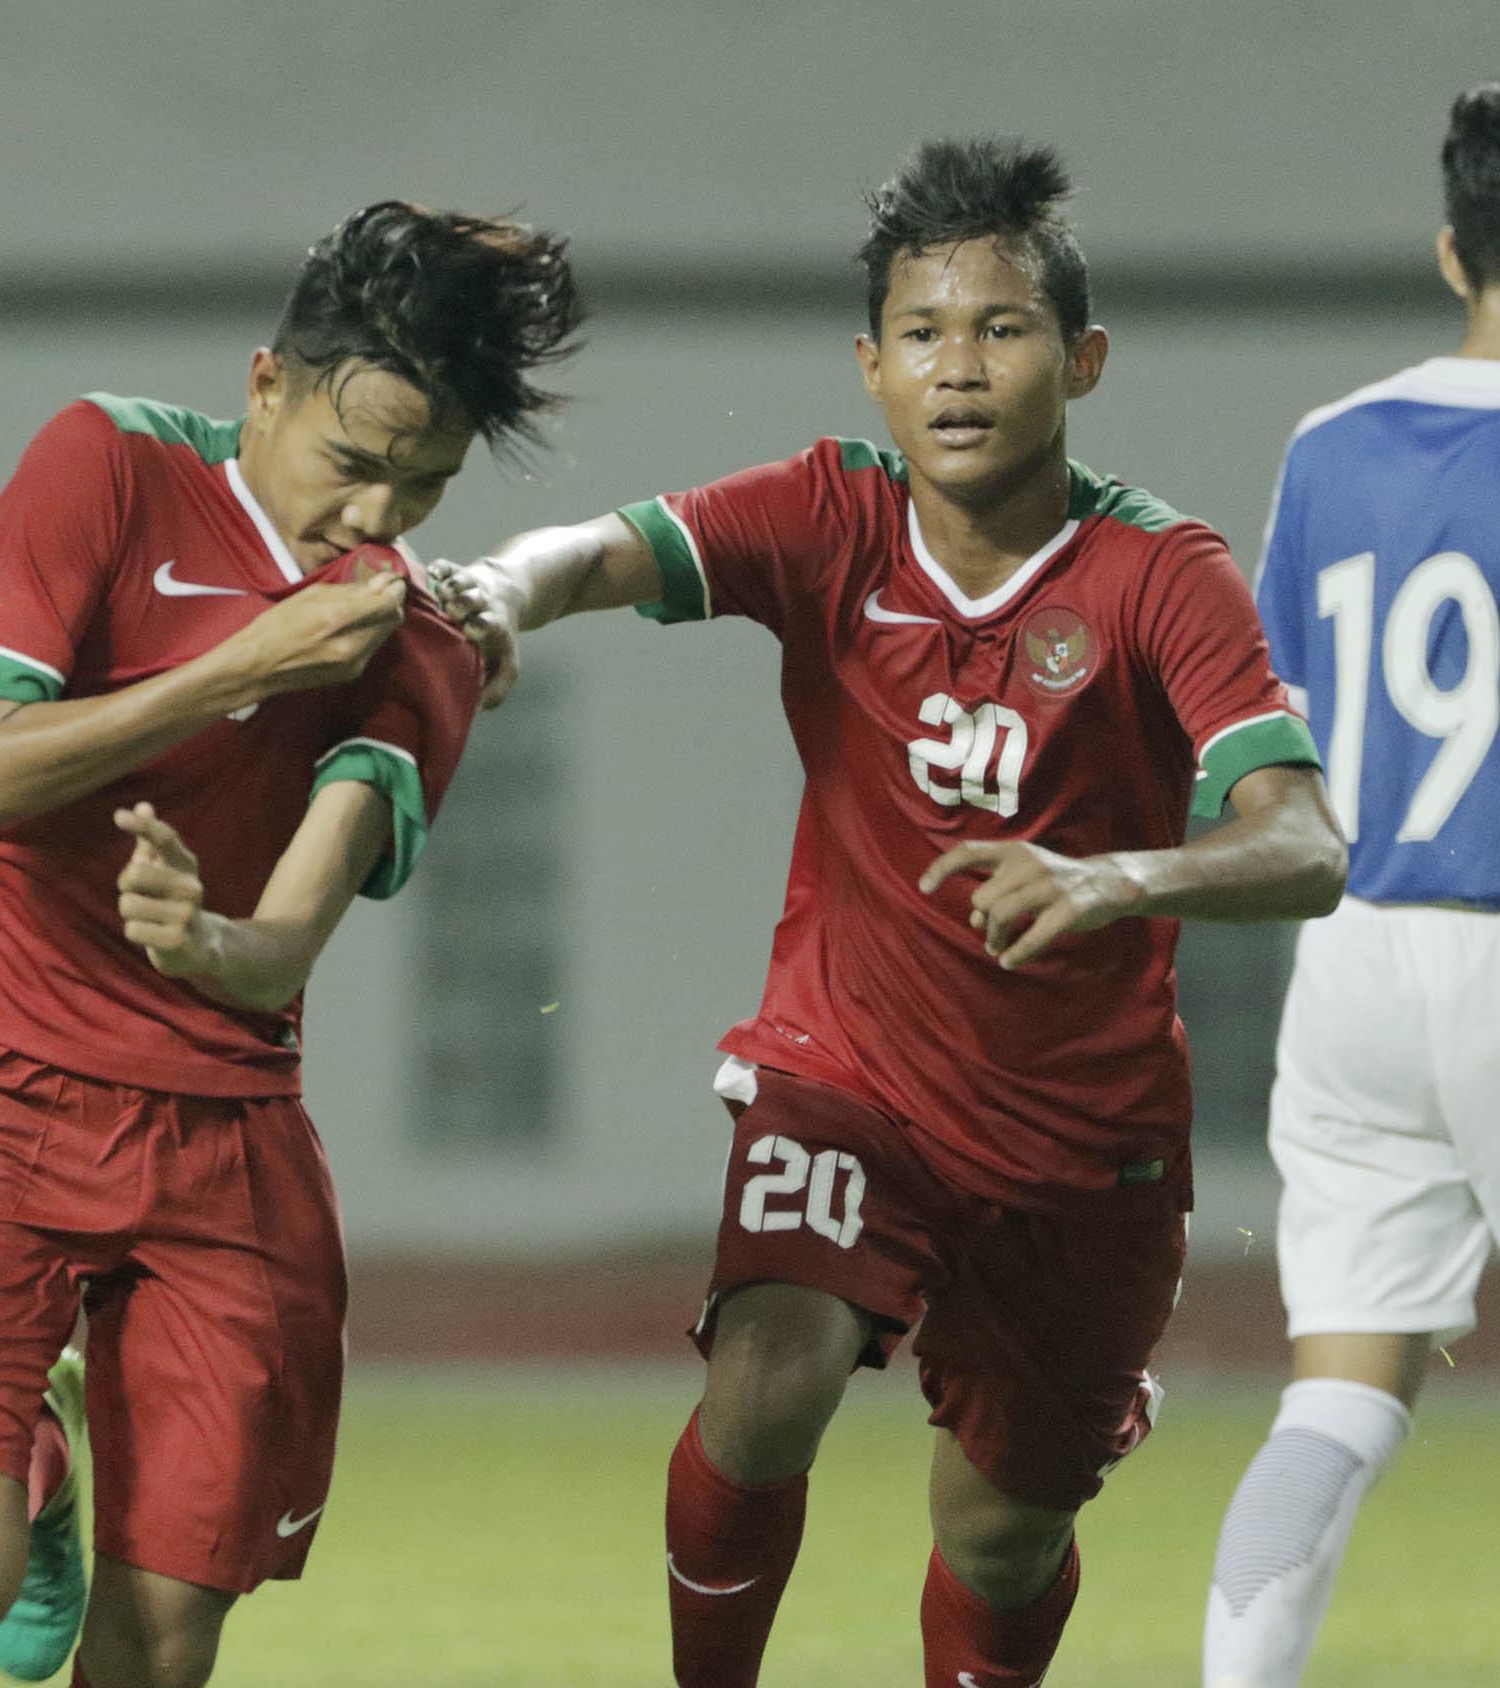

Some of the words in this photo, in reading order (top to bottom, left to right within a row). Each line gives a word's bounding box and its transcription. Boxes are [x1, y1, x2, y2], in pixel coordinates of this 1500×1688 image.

[907, 692, 1028, 818] 20
[1317, 551, 1500, 843] 19
[739, 1135, 867, 1249] 20
